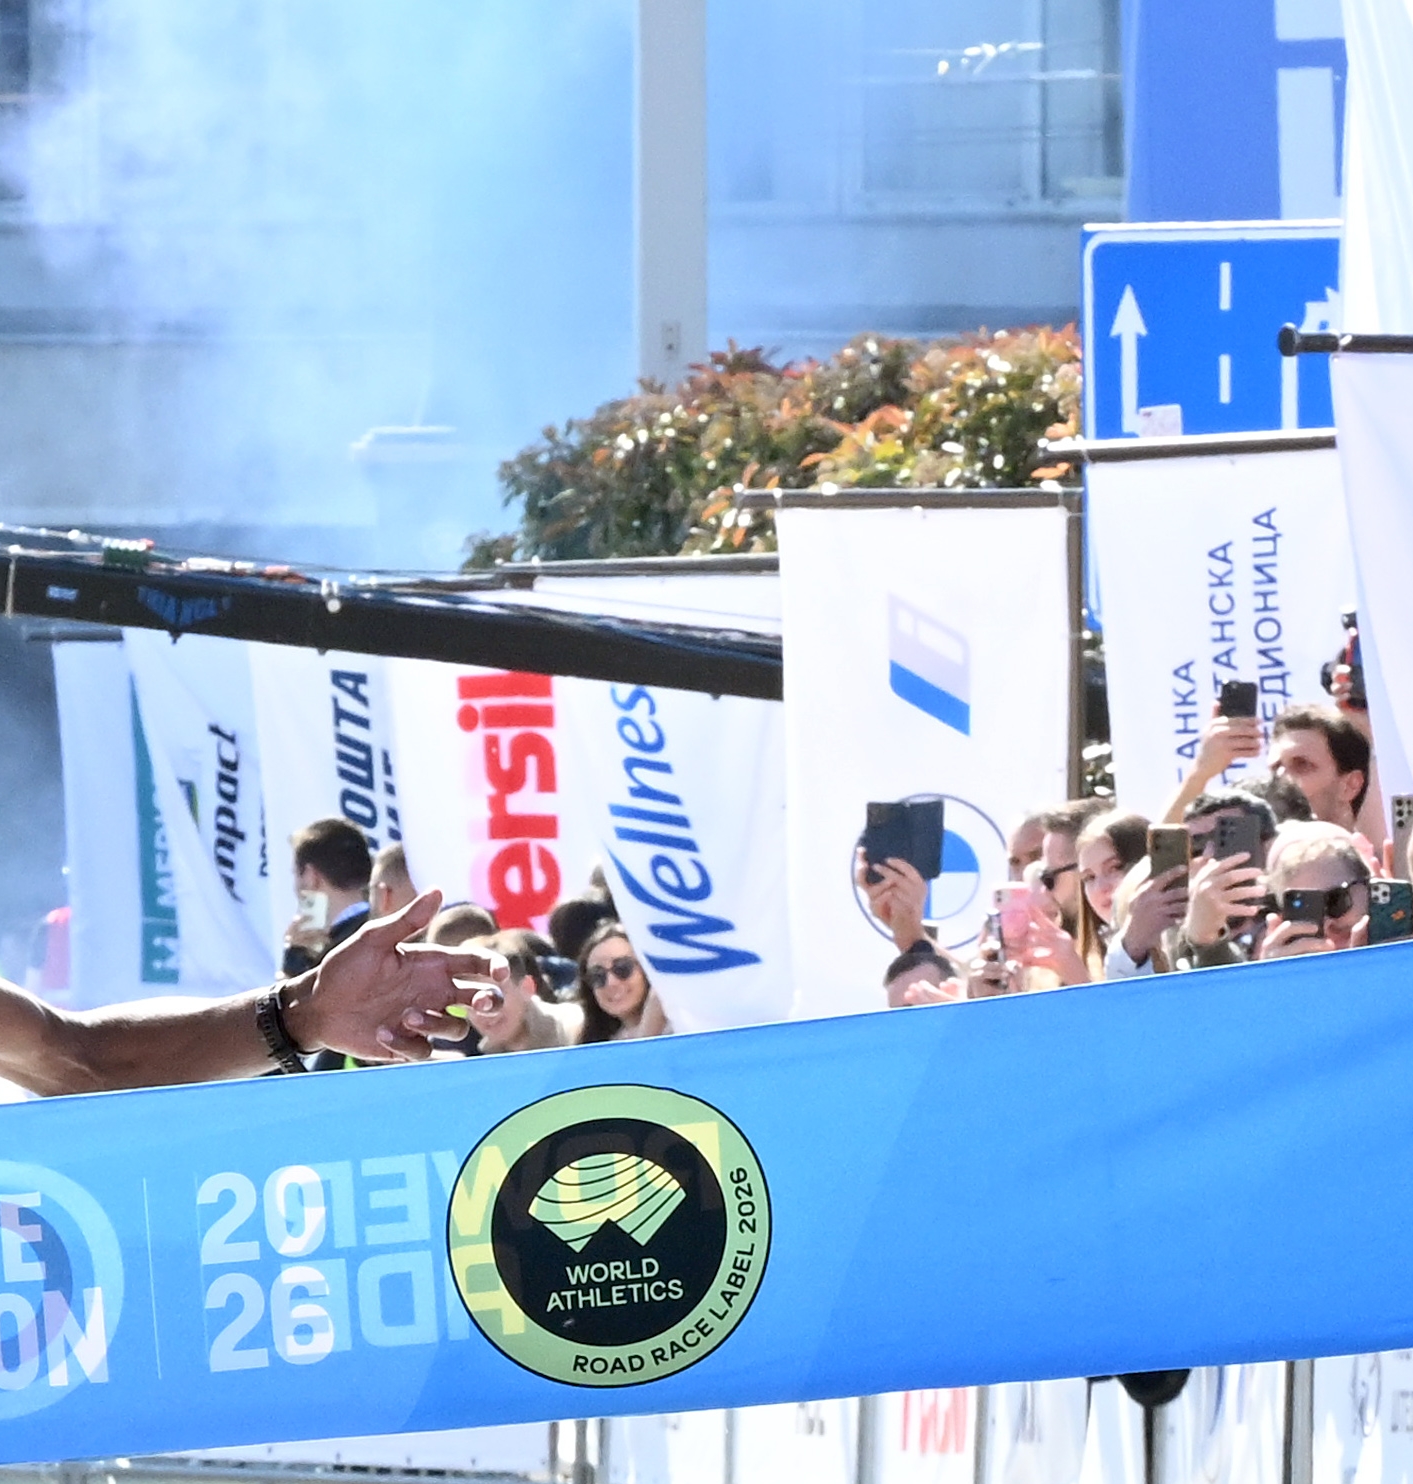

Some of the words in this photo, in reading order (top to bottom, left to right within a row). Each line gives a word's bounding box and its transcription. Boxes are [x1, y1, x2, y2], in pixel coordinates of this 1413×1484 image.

[1251, 506, 1292, 755] ЕДИОНИЦА
[330, 669, 380, 851] ОШТА
[1171, 661, 1200, 782] АНКА
[456, 671, 560, 929] ersil
[196, 1164, 327, 1265] 20
[729, 1166, 757, 1234] 2026
[546, 1279, 684, 1311] ATHLETICS
[565, 1256, 661, 1286] WORLD
[709, 1242, 756, 1321] LABEL
[204, 1267, 335, 1373] 26
[572, 1353, 646, 1375] ROAD
[650, 1317, 715, 1366] RACE
